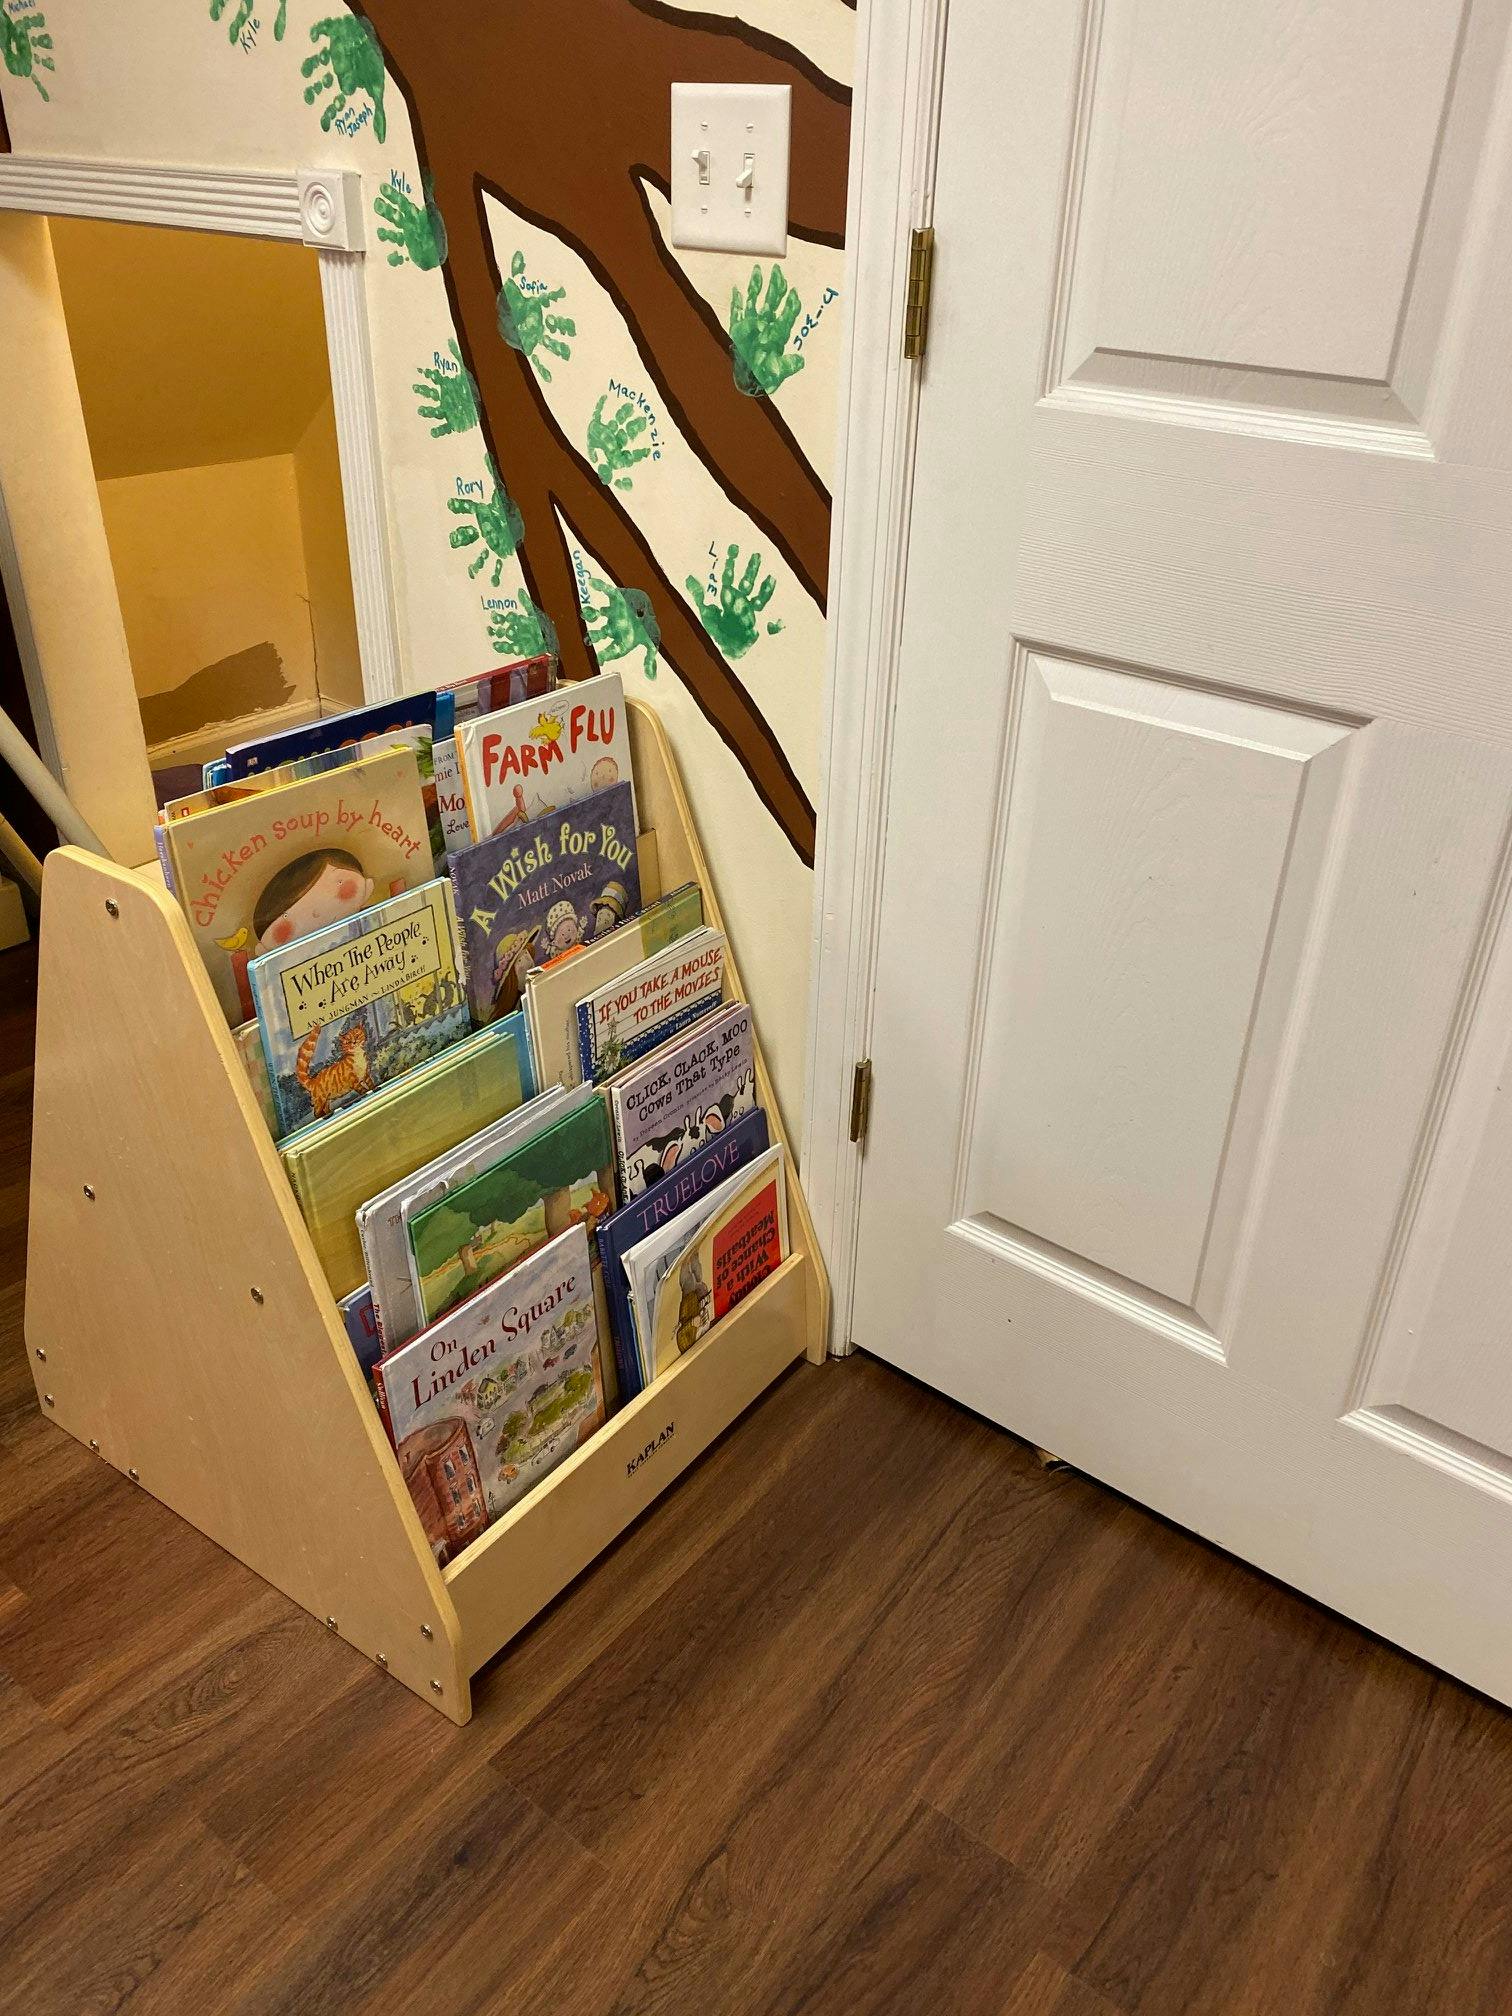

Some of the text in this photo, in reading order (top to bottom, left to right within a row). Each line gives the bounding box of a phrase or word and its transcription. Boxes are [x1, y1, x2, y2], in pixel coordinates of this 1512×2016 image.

[239, 18, 260, 54] Kyle
[390, 168, 412, 194] Kyle
[520, 276, 548, 295] Sofia
[434, 351, 458, 375] Ryan
[608, 378, 665, 462] Mackenzie
[456, 477, 484, 499] Rory
[481, 595, 518, 611] Lennon
[573, 550, 592, 604] Keegan
[482, 705, 615, 787] FARM FLU
[272, 811, 329, 840] soup
[336, 800, 363, 832] by
[368, 800, 421, 860] heart
[468, 822, 635, 938] A Wish for You
[517, 862, 593, 910] Matt Novak
[290, 921, 422, 997] When The People
[330, 950, 406, 1004] Are Away
[599, 948, 722, 1025] IF YOU TAKE A MOUSE
[307, 966, 426, 1029] ANN JUNGMAN LINDA BIRCH
[633, 967, 721, 1024] TO THE MOVIES
[626, 1019, 748, 1110] CLICK, CLACK, MOO
[639, 1045, 741, 1122] Cows That Type
[636, 1139, 742, 1233] TRUELOVE
[716, 1210, 774, 1269] Meatballs
[716, 1227, 775, 1290] Chance of
[727, 1249, 769, 1291] With a
[410, 1273, 577, 1411] Linden Square
[430, 1336, 458, 1363] On
[626, 1421, 675, 1477] KAPLAN
